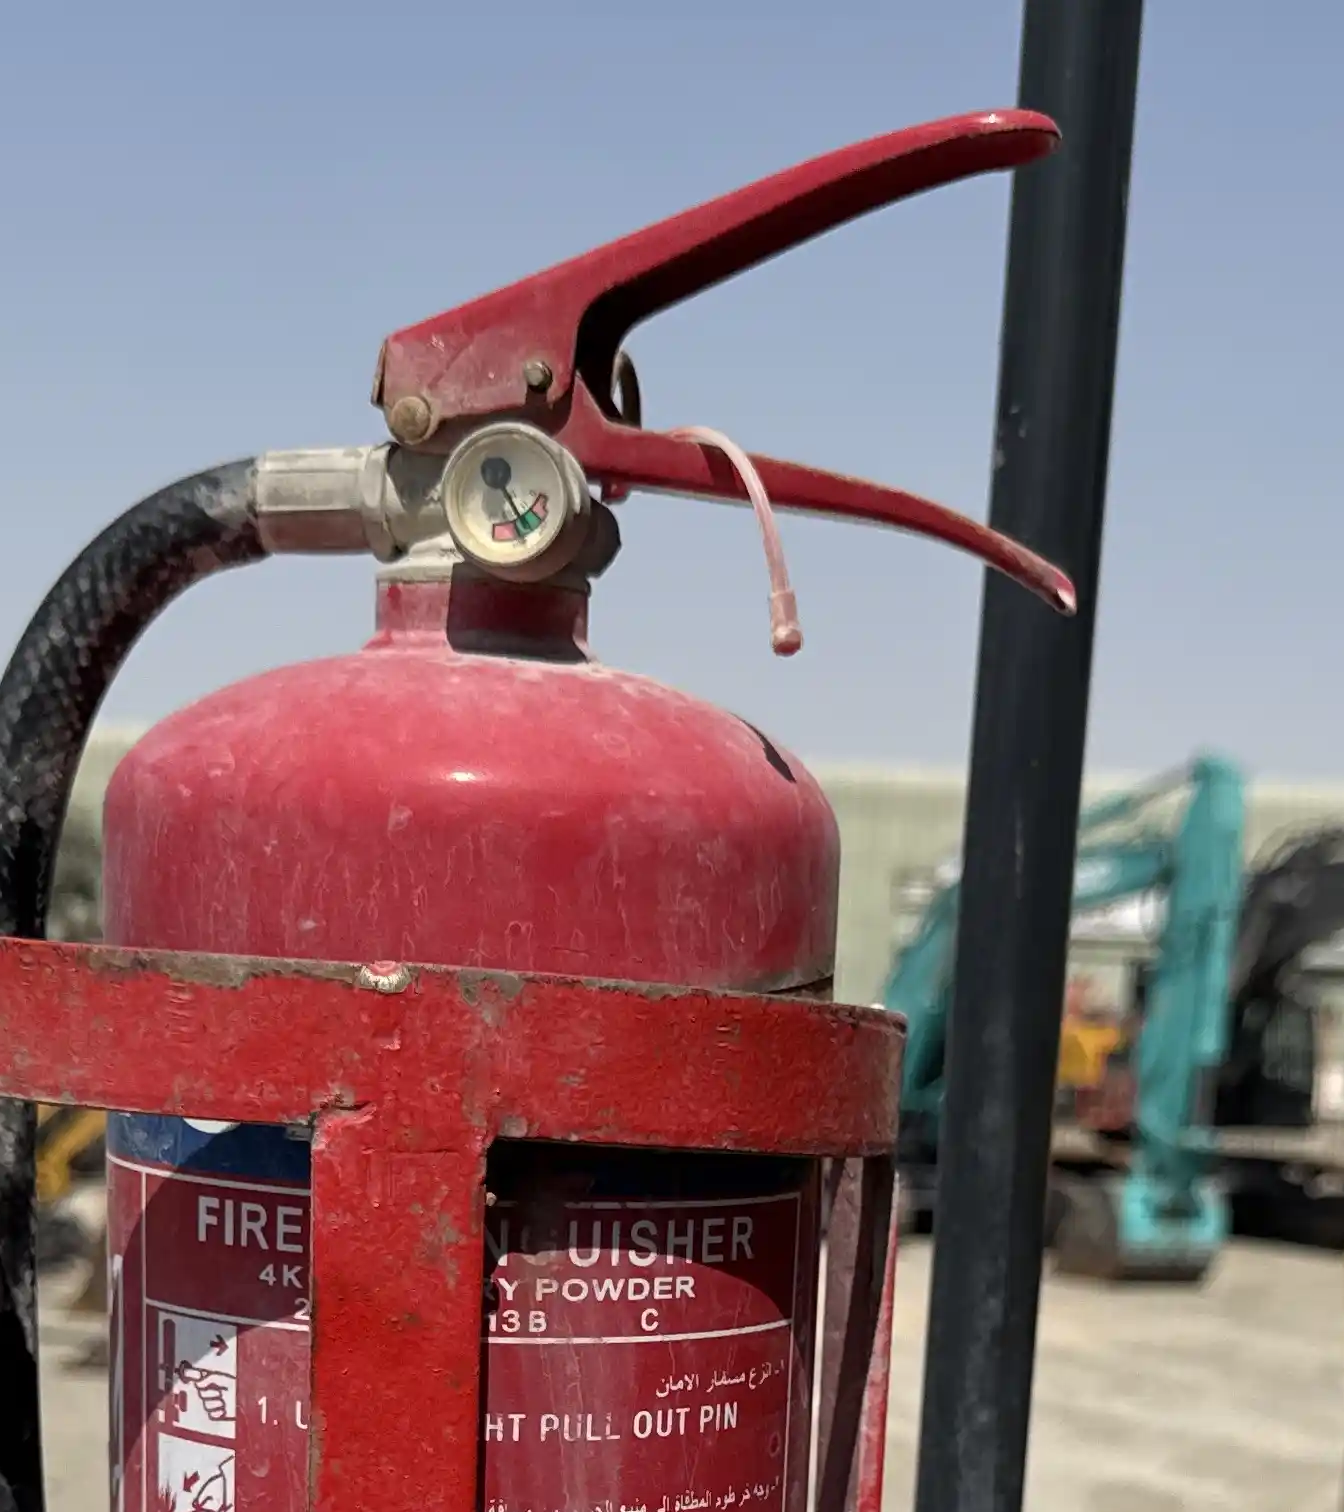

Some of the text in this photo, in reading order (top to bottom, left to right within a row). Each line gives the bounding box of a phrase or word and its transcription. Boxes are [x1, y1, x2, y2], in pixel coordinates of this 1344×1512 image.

[197, 1195, 304, 1254] FIRE
[535, 1276, 696, 1302] POWDER
[640, 1308, 659, 1332] C
[257, 1396, 279, 1426] 1.
[540, 1412, 621, 1442] PULL
[633, 1407, 692, 1439] OUT
[699, 1401, 739, 1433] PIN
